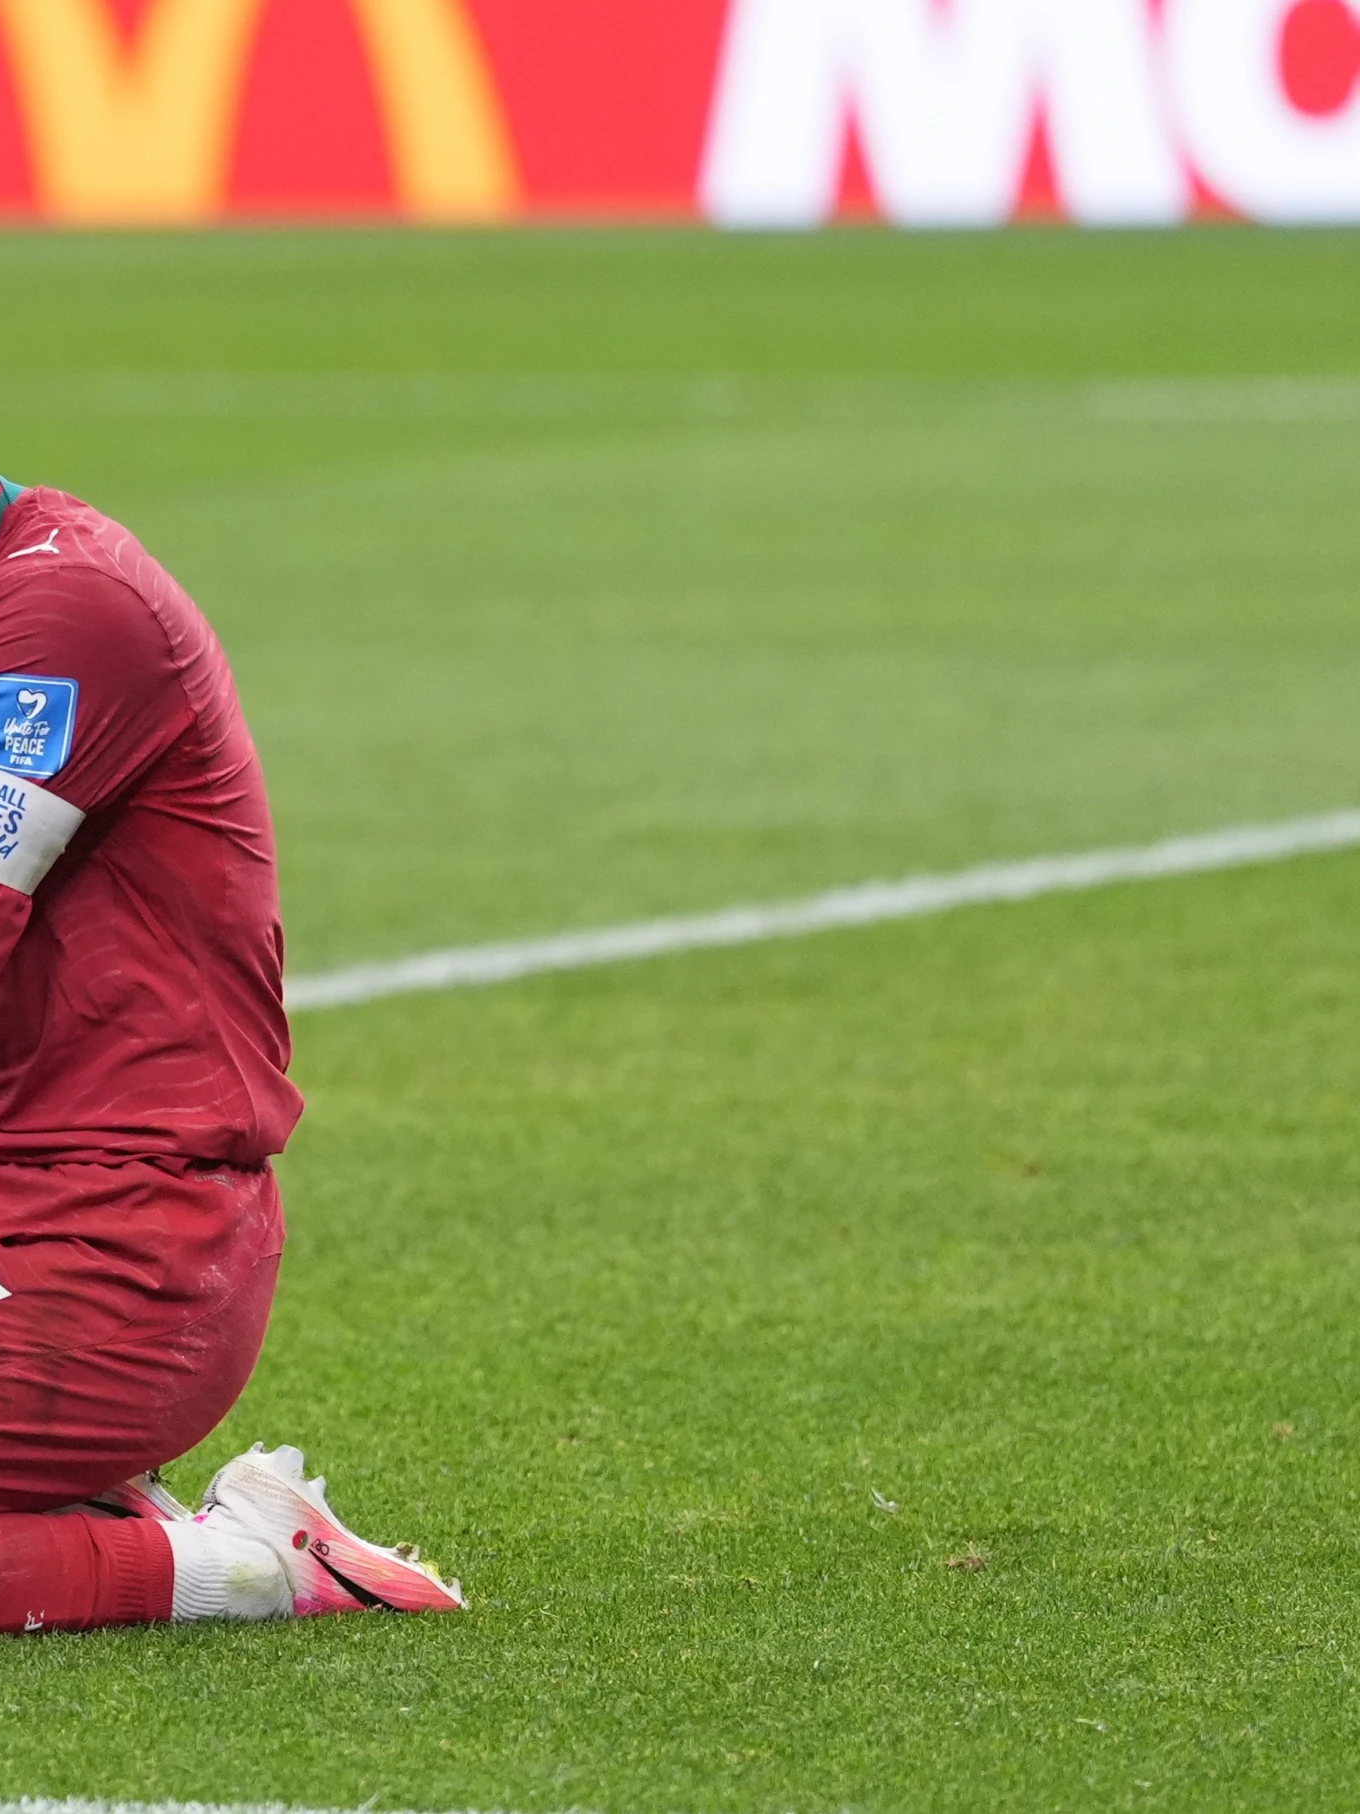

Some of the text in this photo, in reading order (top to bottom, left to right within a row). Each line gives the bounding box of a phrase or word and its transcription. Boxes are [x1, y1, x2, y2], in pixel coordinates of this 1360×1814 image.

[3, 717, 51, 738] Unite For
[4, 735, 46, 756] PEACE
[9, 754, 34, 766] FIFA
